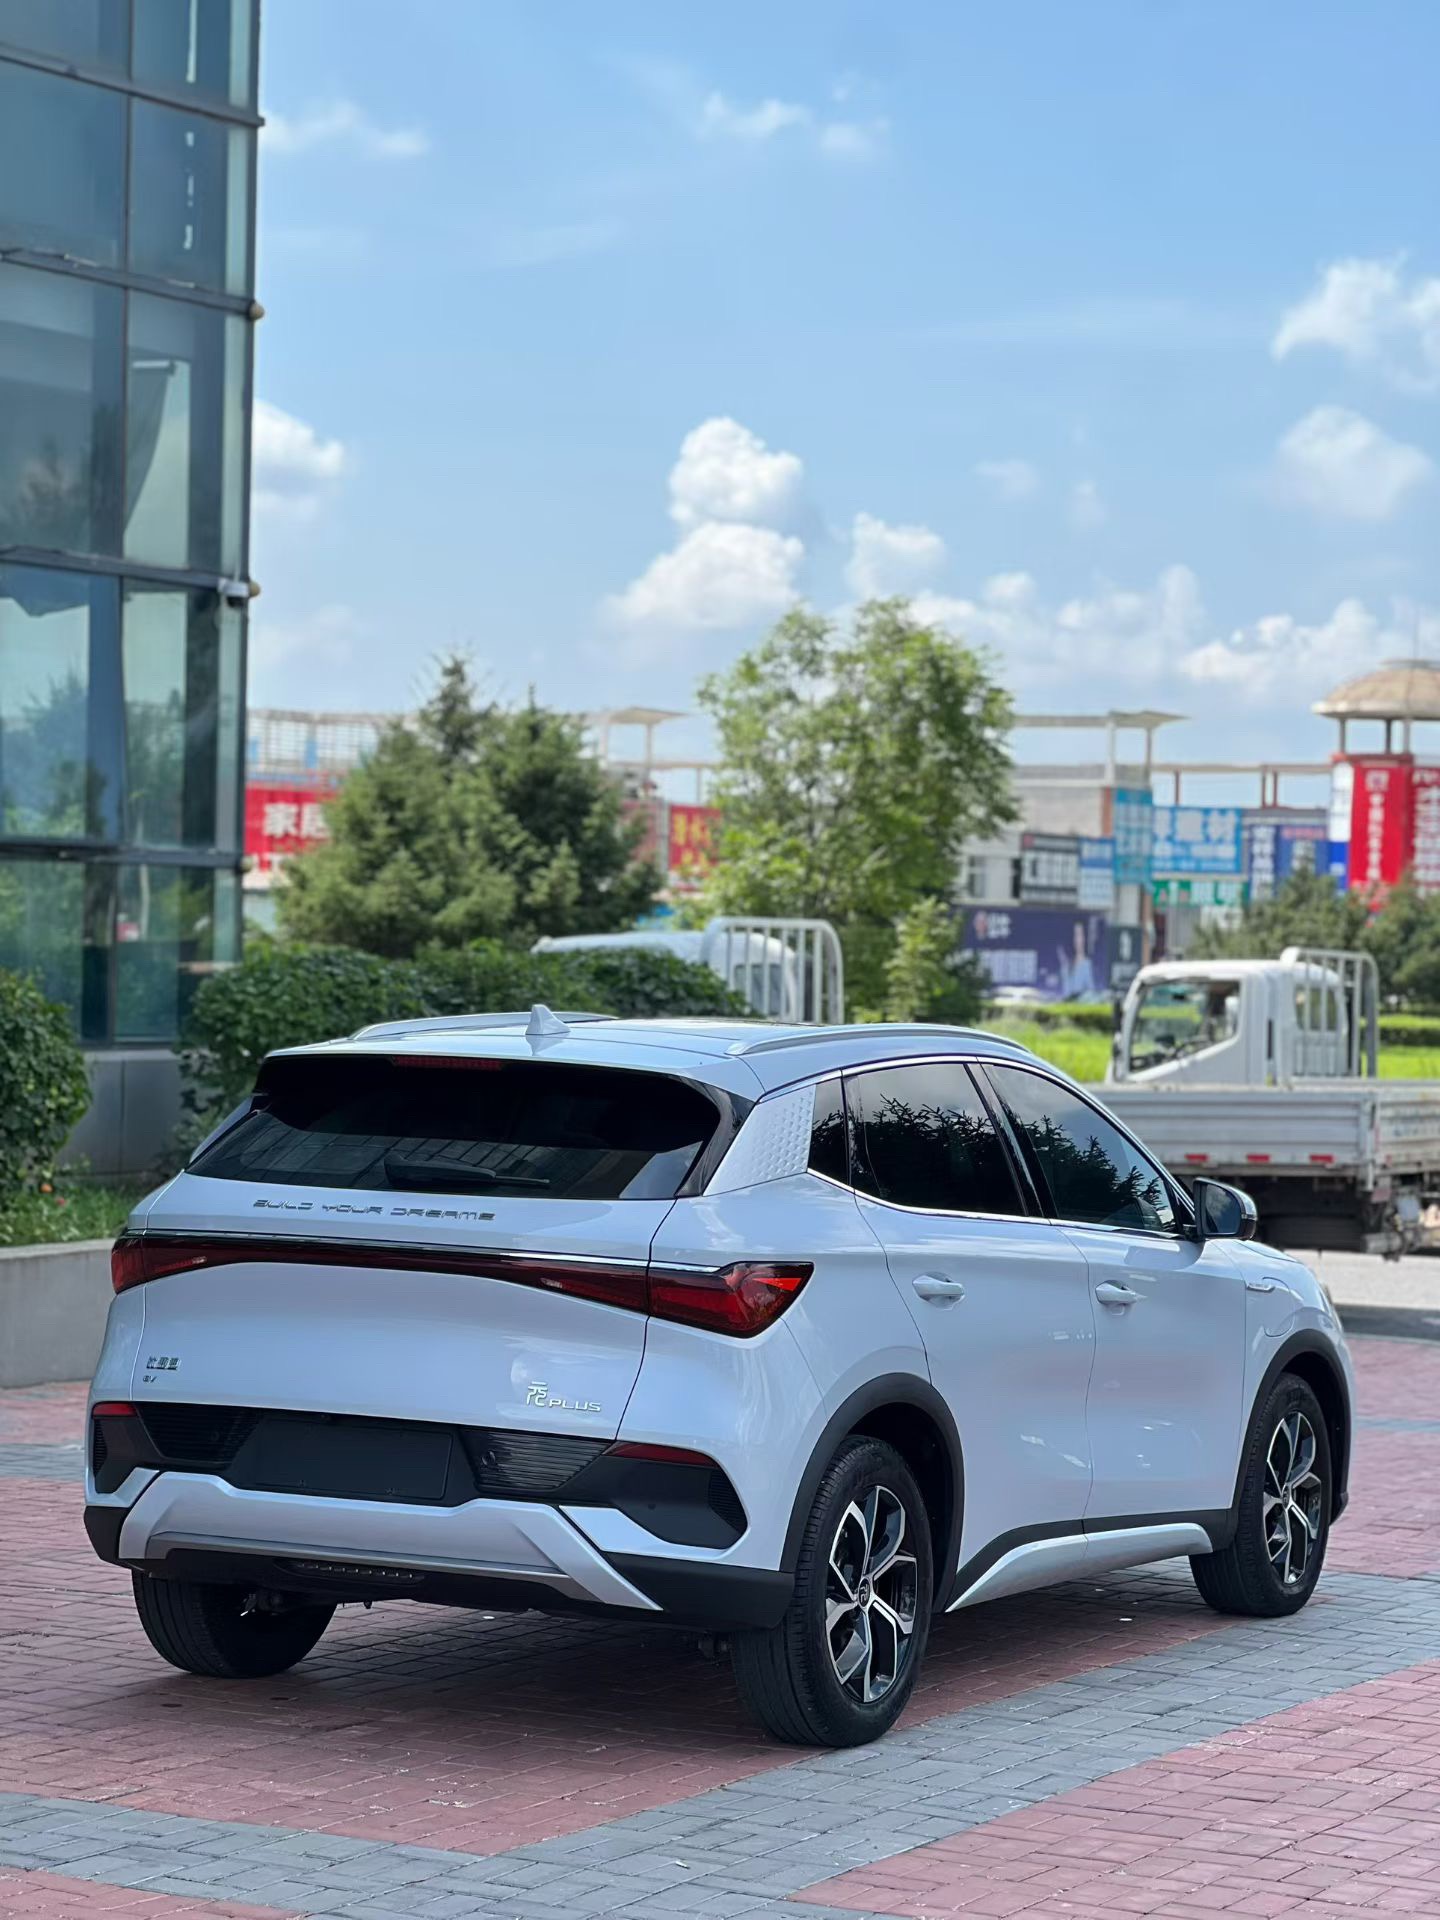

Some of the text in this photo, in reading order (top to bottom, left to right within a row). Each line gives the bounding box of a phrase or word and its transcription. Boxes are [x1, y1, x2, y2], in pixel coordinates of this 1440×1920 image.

[322, 1204, 383, 1215] YOUR
[390, 1207, 496, 1221] DREAMS
[548, 1398, 602, 1412] PLUS
